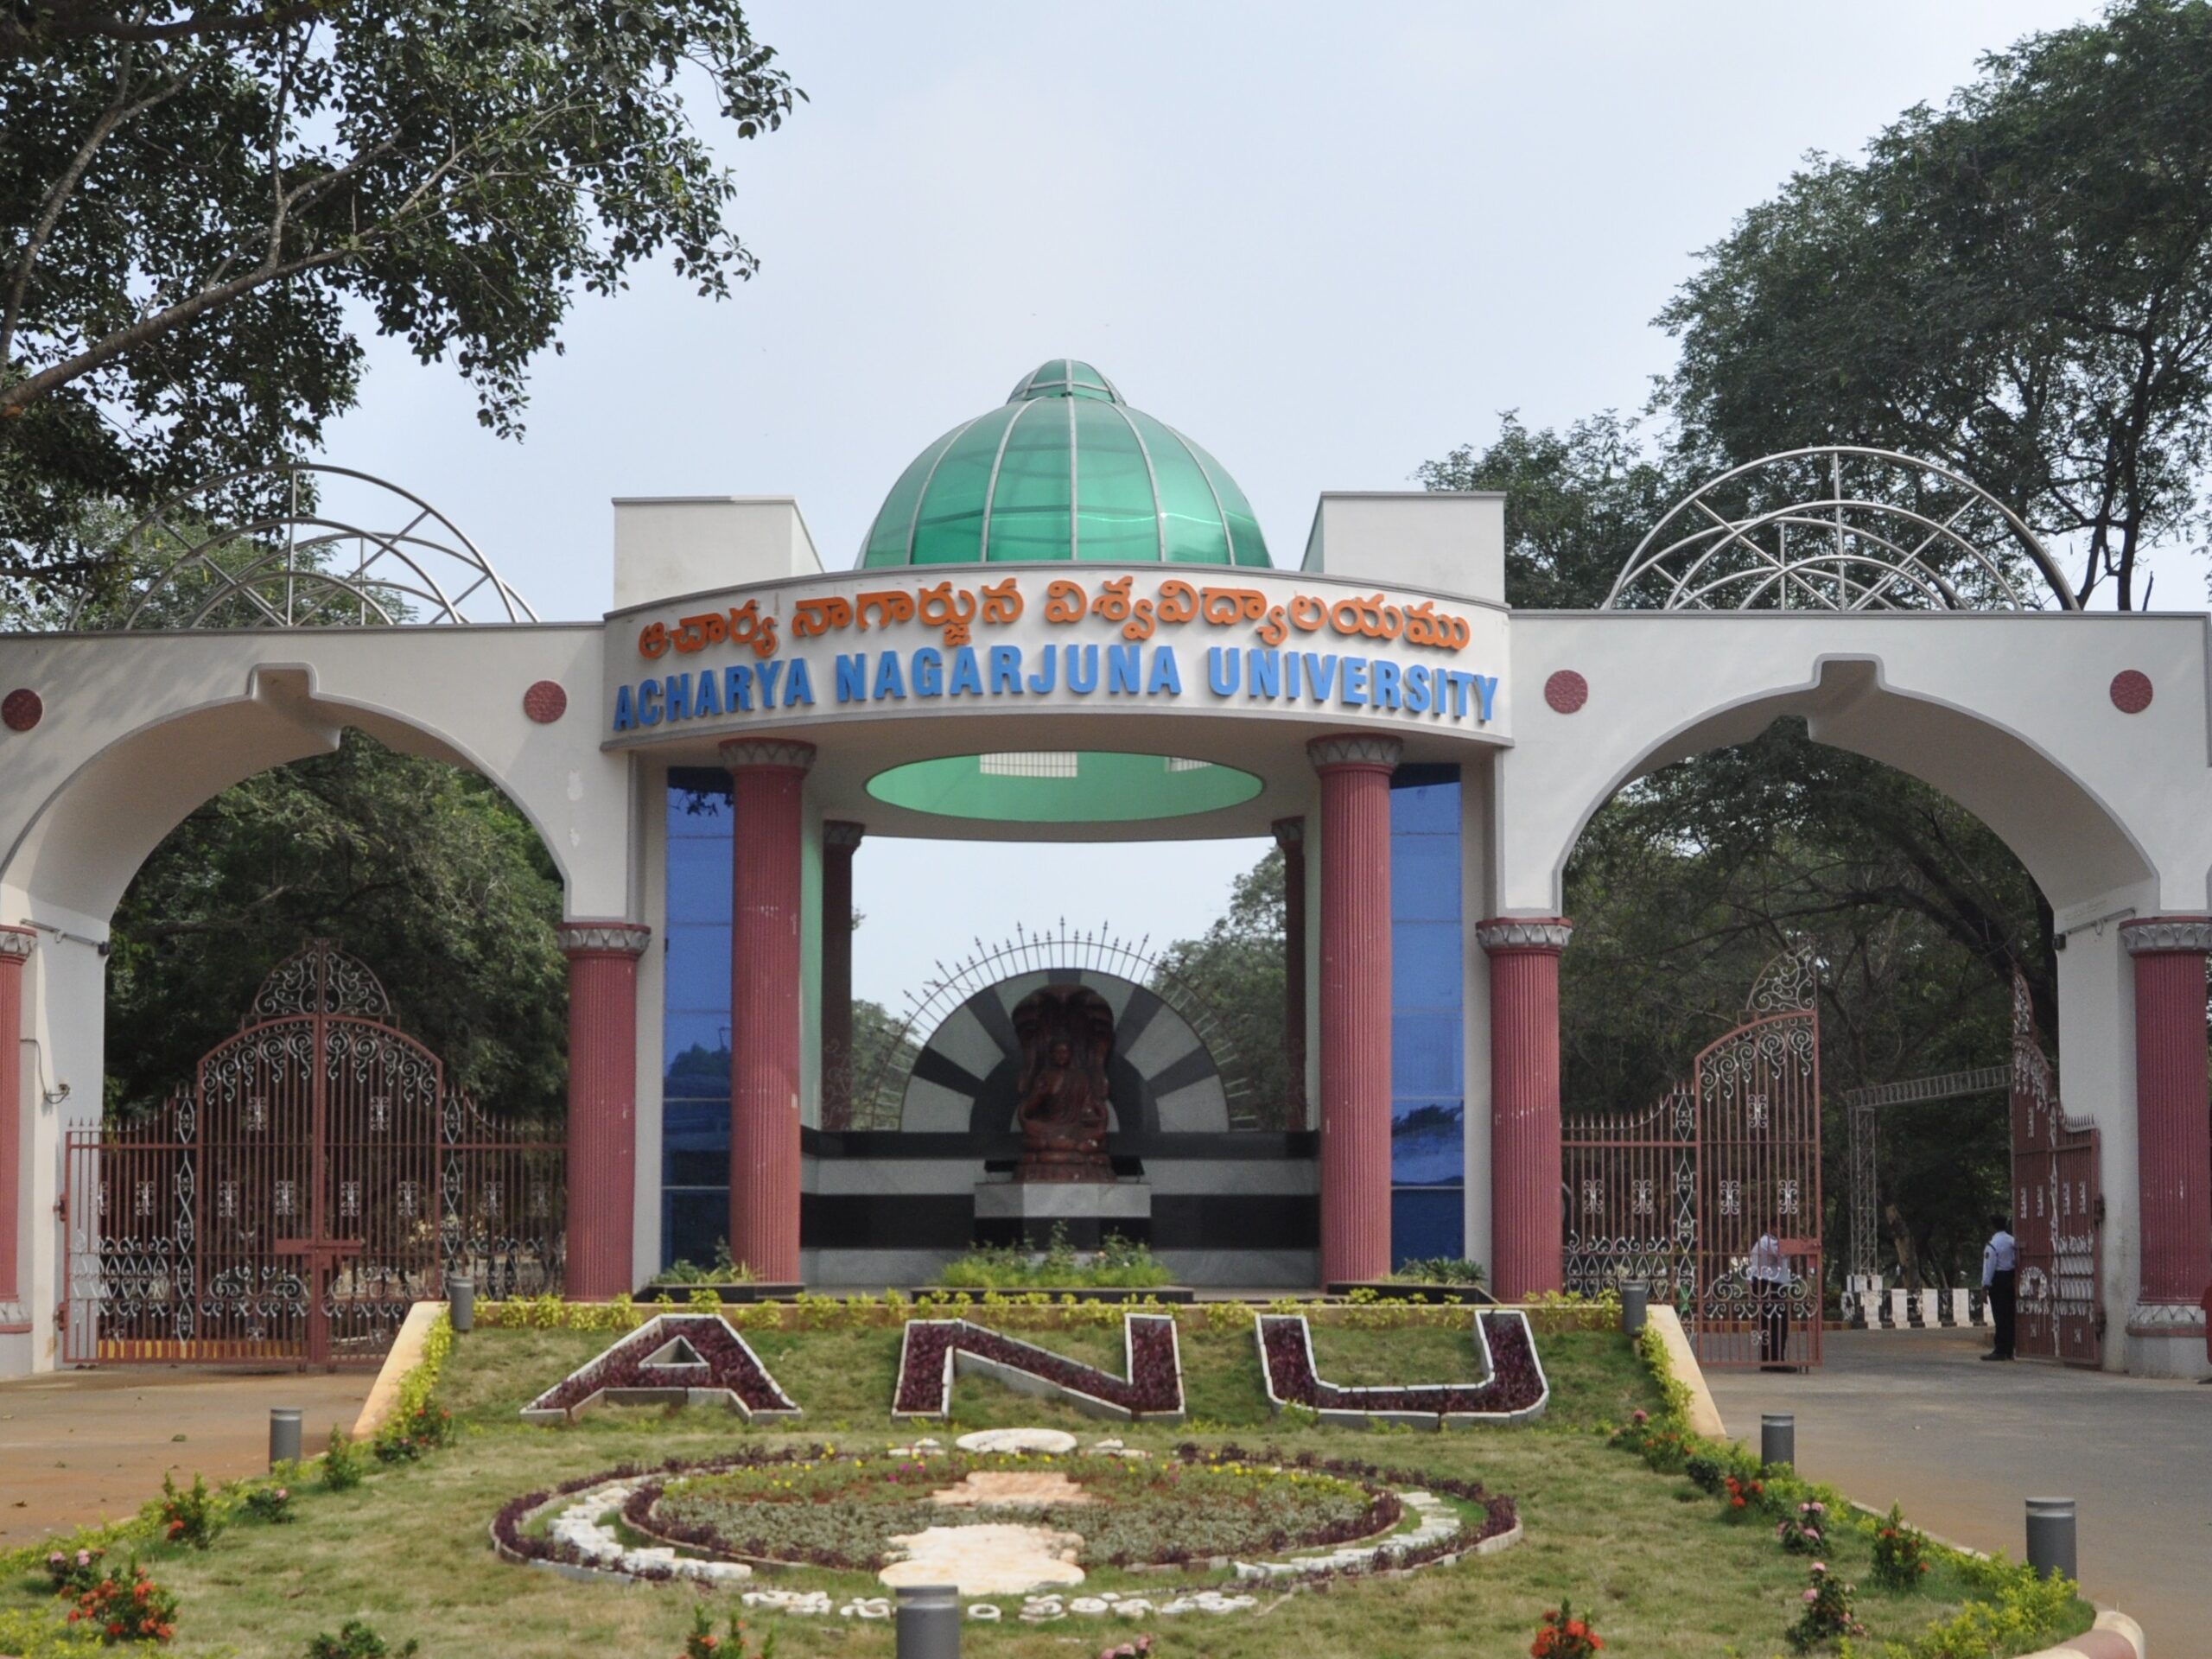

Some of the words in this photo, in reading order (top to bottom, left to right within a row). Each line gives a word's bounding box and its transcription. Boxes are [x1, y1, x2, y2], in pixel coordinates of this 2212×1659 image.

[639, 599, 778, 658] ఆచార్య
[791, 577, 1024, 646] నాగార్జున
[1045, 575, 1471, 651] విశ్వవిద్యాలయము
[613, 658, 815, 732] ACHARYA
[836, 644, 1182, 702] NAGARJUNA
[1209, 646, 1498, 721] UNIVERSITY
[518, 1309, 1550, 1431] ANU
